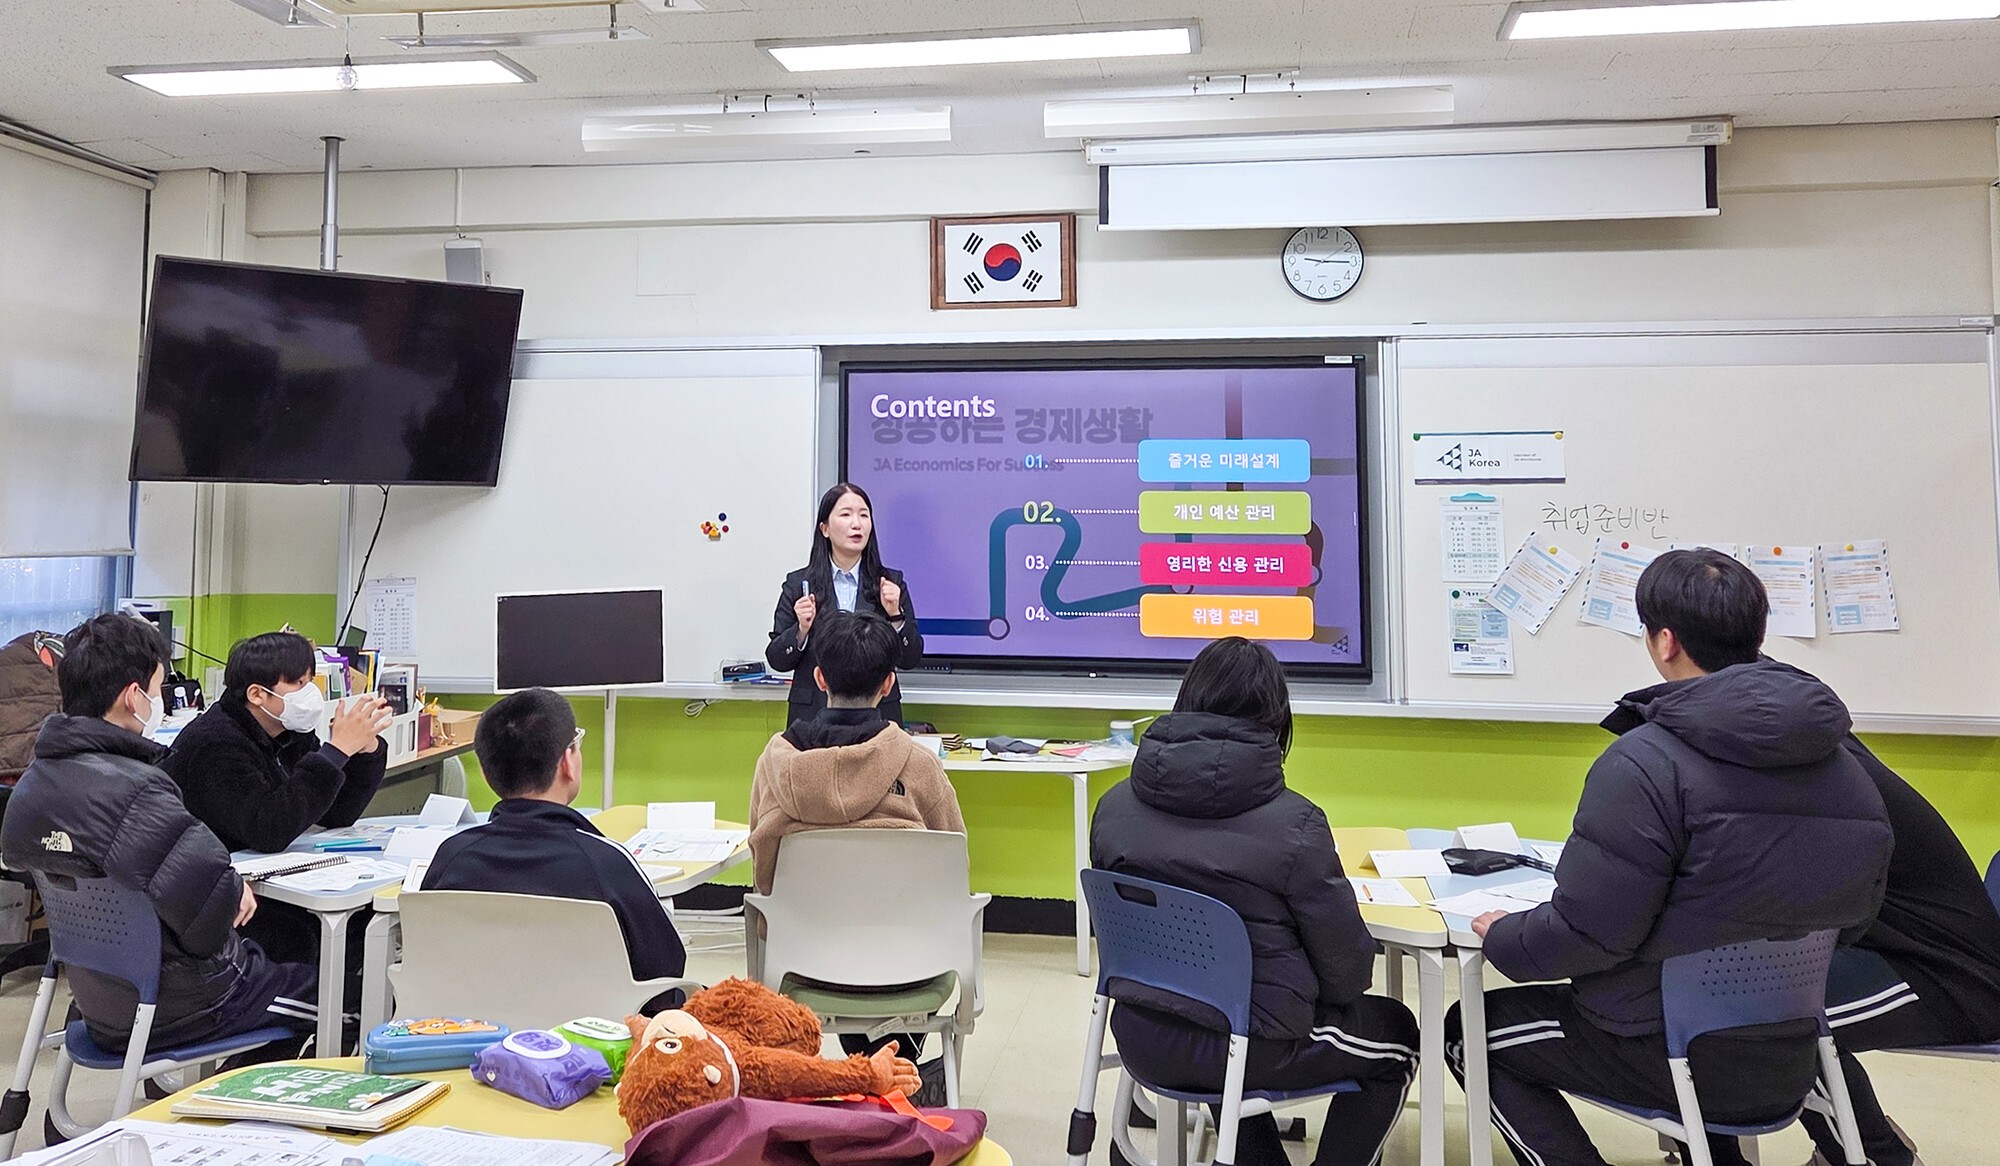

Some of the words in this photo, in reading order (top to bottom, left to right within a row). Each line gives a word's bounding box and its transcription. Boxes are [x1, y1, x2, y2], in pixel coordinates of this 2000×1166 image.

[1305, 232, 1313, 244] 11
[1317, 228, 1328, 239] 12
[1293, 243, 1306, 254] 10
[1343, 241, 1352, 253] 2
[1288, 256, 1296, 268] 9
[1349, 255, 1357, 267] 3
[1293, 270, 1301, 281] 8
[1343, 270, 1351, 280] 4
[1305, 280, 1312, 291] 7
[1318, 283, 1327, 295] 6
[1333, 280, 1341, 292] 5
[871, 394, 995, 418] Contents
[1015, 407, 1153, 444] 경제생활
[1468, 449, 1482, 458] JA
[874, 458, 892, 472] JA
[894, 457, 975, 472] Economics
[977, 458, 1002, 472] For
[1025, 454, 1048, 469] 01.
[1167, 453, 1213, 469] 즐거운
[1219, 452, 1280, 469] 미래설계
[1469, 459, 1501, 468] Korea
[1023, 501, 1062, 523] 02.
[1173, 504, 1203, 521] 개인
[1209, 504, 1240, 521] 예산
[1245, 505, 1276, 521] 관리
[1025, 555, 1050, 571] 03.
[1166, 556, 1213, 572] 영리한
[1217, 556, 1249, 573] 신용
[1253, 556, 1284, 573] 관리
[1025, 606, 1050, 621] 04.
[1192, 609, 1223, 625] 위험
[1228, 609, 1260, 625] 관리
